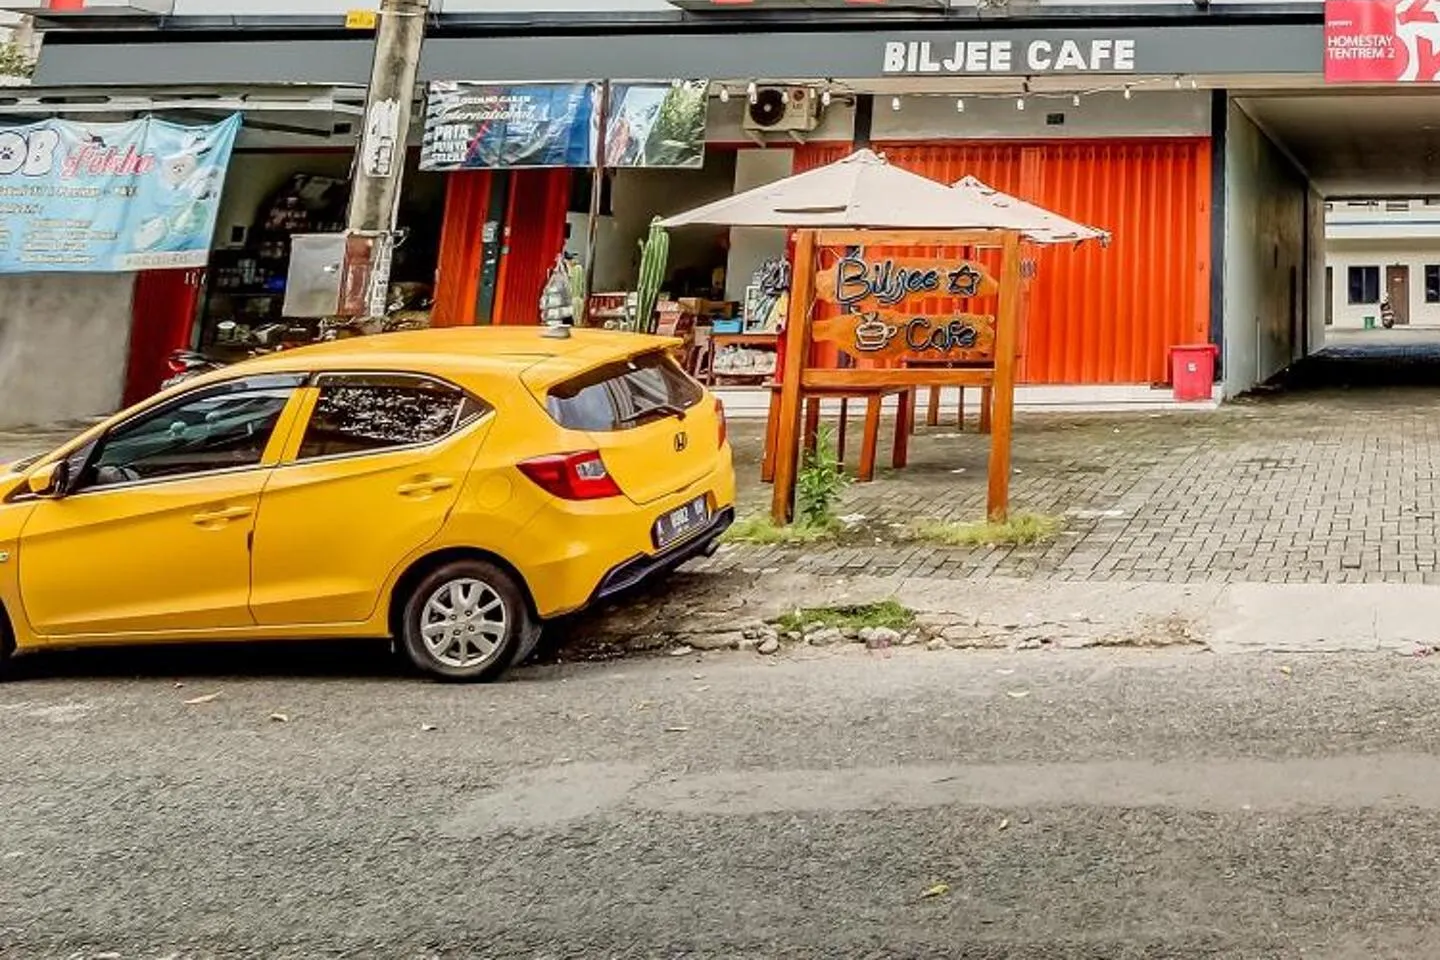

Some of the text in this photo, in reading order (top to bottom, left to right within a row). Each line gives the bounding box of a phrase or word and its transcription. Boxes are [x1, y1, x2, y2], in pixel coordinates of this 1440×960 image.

[883, 39, 1136, 72] BILJEE CAFE
[1327, 34, 1394, 47] HOMESTAY
[1328, 47, 1396, 60] TENTREM 2
[835, 256, 938, 306] Biljee
[905, 316, 977, 353] Cafe
